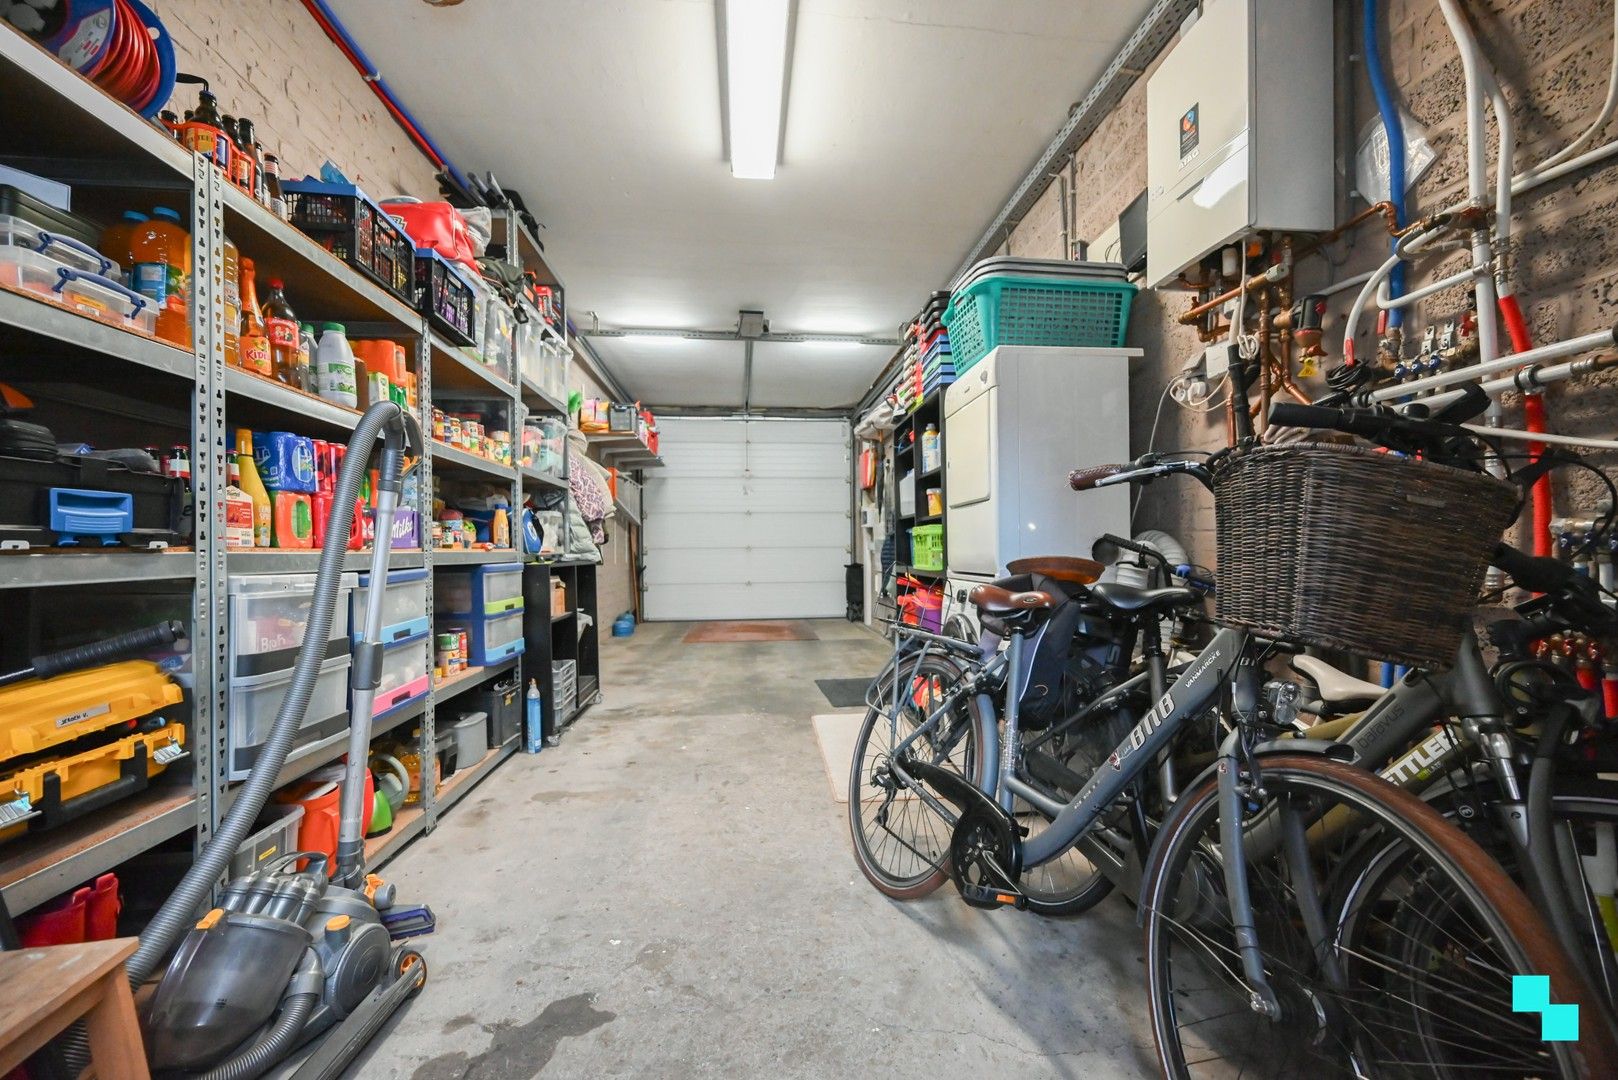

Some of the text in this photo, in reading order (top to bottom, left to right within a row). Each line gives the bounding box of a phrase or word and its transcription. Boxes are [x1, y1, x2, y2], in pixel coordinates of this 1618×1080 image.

[1185, 649, 1221, 688] VANMARCKE
[1357, 704, 1404, 748] batavus
[1380, 724, 1461, 786] ETTLER
